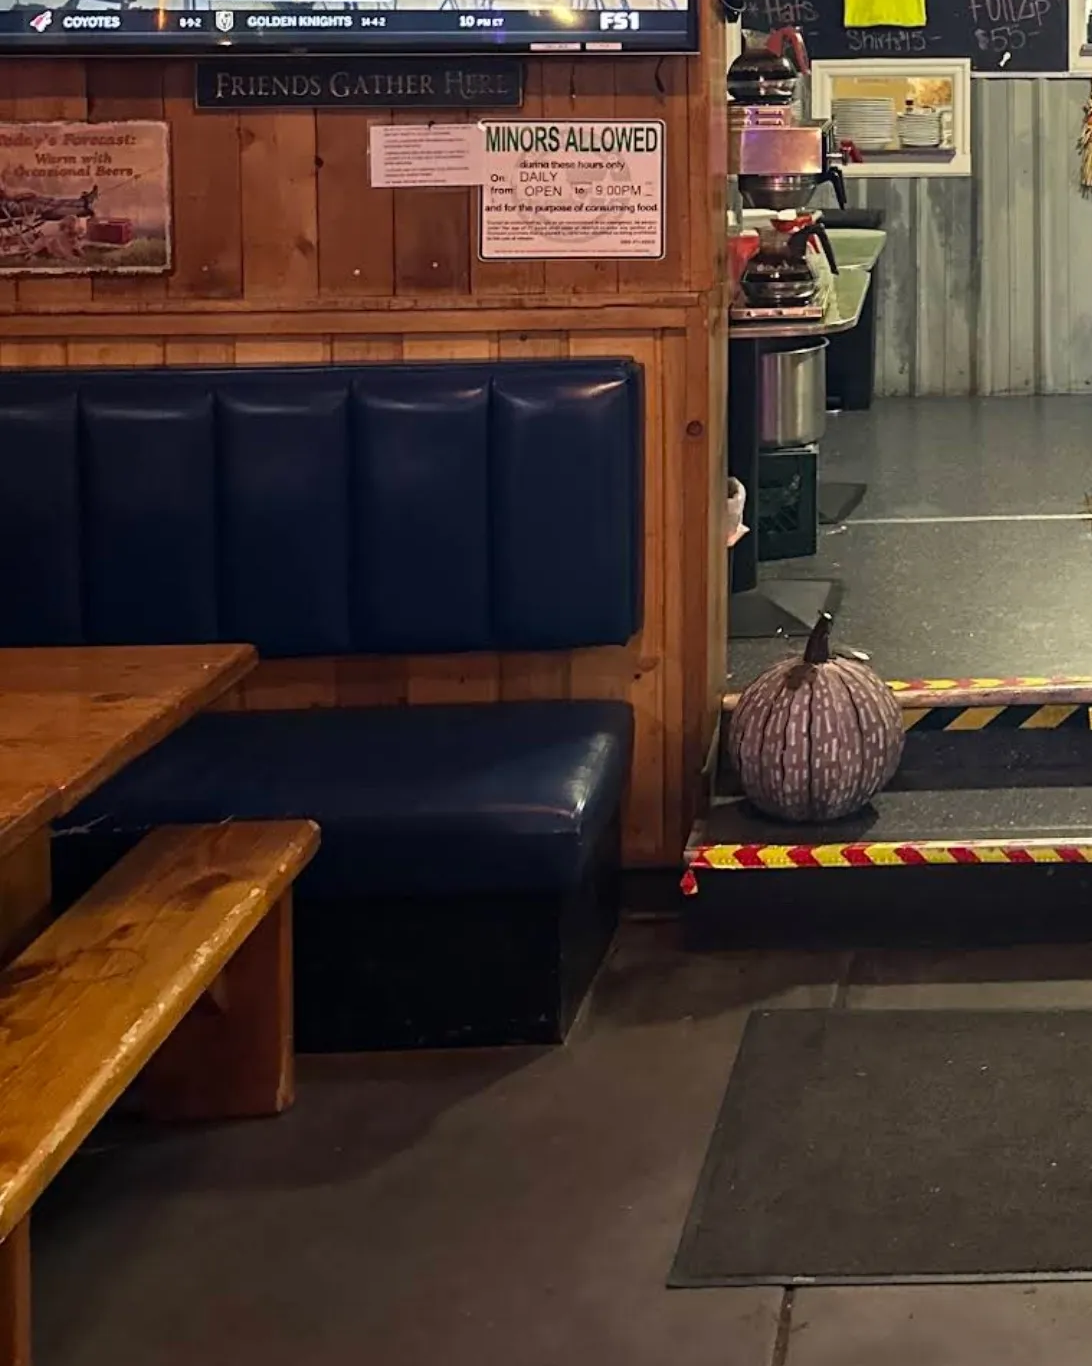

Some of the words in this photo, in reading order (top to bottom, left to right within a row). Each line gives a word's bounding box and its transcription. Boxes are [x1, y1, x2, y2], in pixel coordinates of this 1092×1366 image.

[62, 15, 121, 29] COYOTES
[246, 15, 298, 27] GOLDEN
[299, 15, 353, 28] KNIGHTS
[459, 15, 475, 27] 10
[476, 18, 491, 27] PM
[599, 11, 640, 30] FS1
[485, 126, 560, 153] MINORS
[565, 126, 658, 152] ALLOWED
[34, 153, 77, 165] Warm
[80, 151, 112, 164] with
[519, 171, 558, 183] DAILY
[524, 186, 562, 196] OPEN
[594, 185, 642, 196] 900PM
[484, 203, 502, 212] and
[504, 203, 517, 212] for
[518, 203, 534, 212] the
[535, 205, 573, 214] purpose
[573, 203, 584, 212] of
[585, 204, 636, 214] consuming
